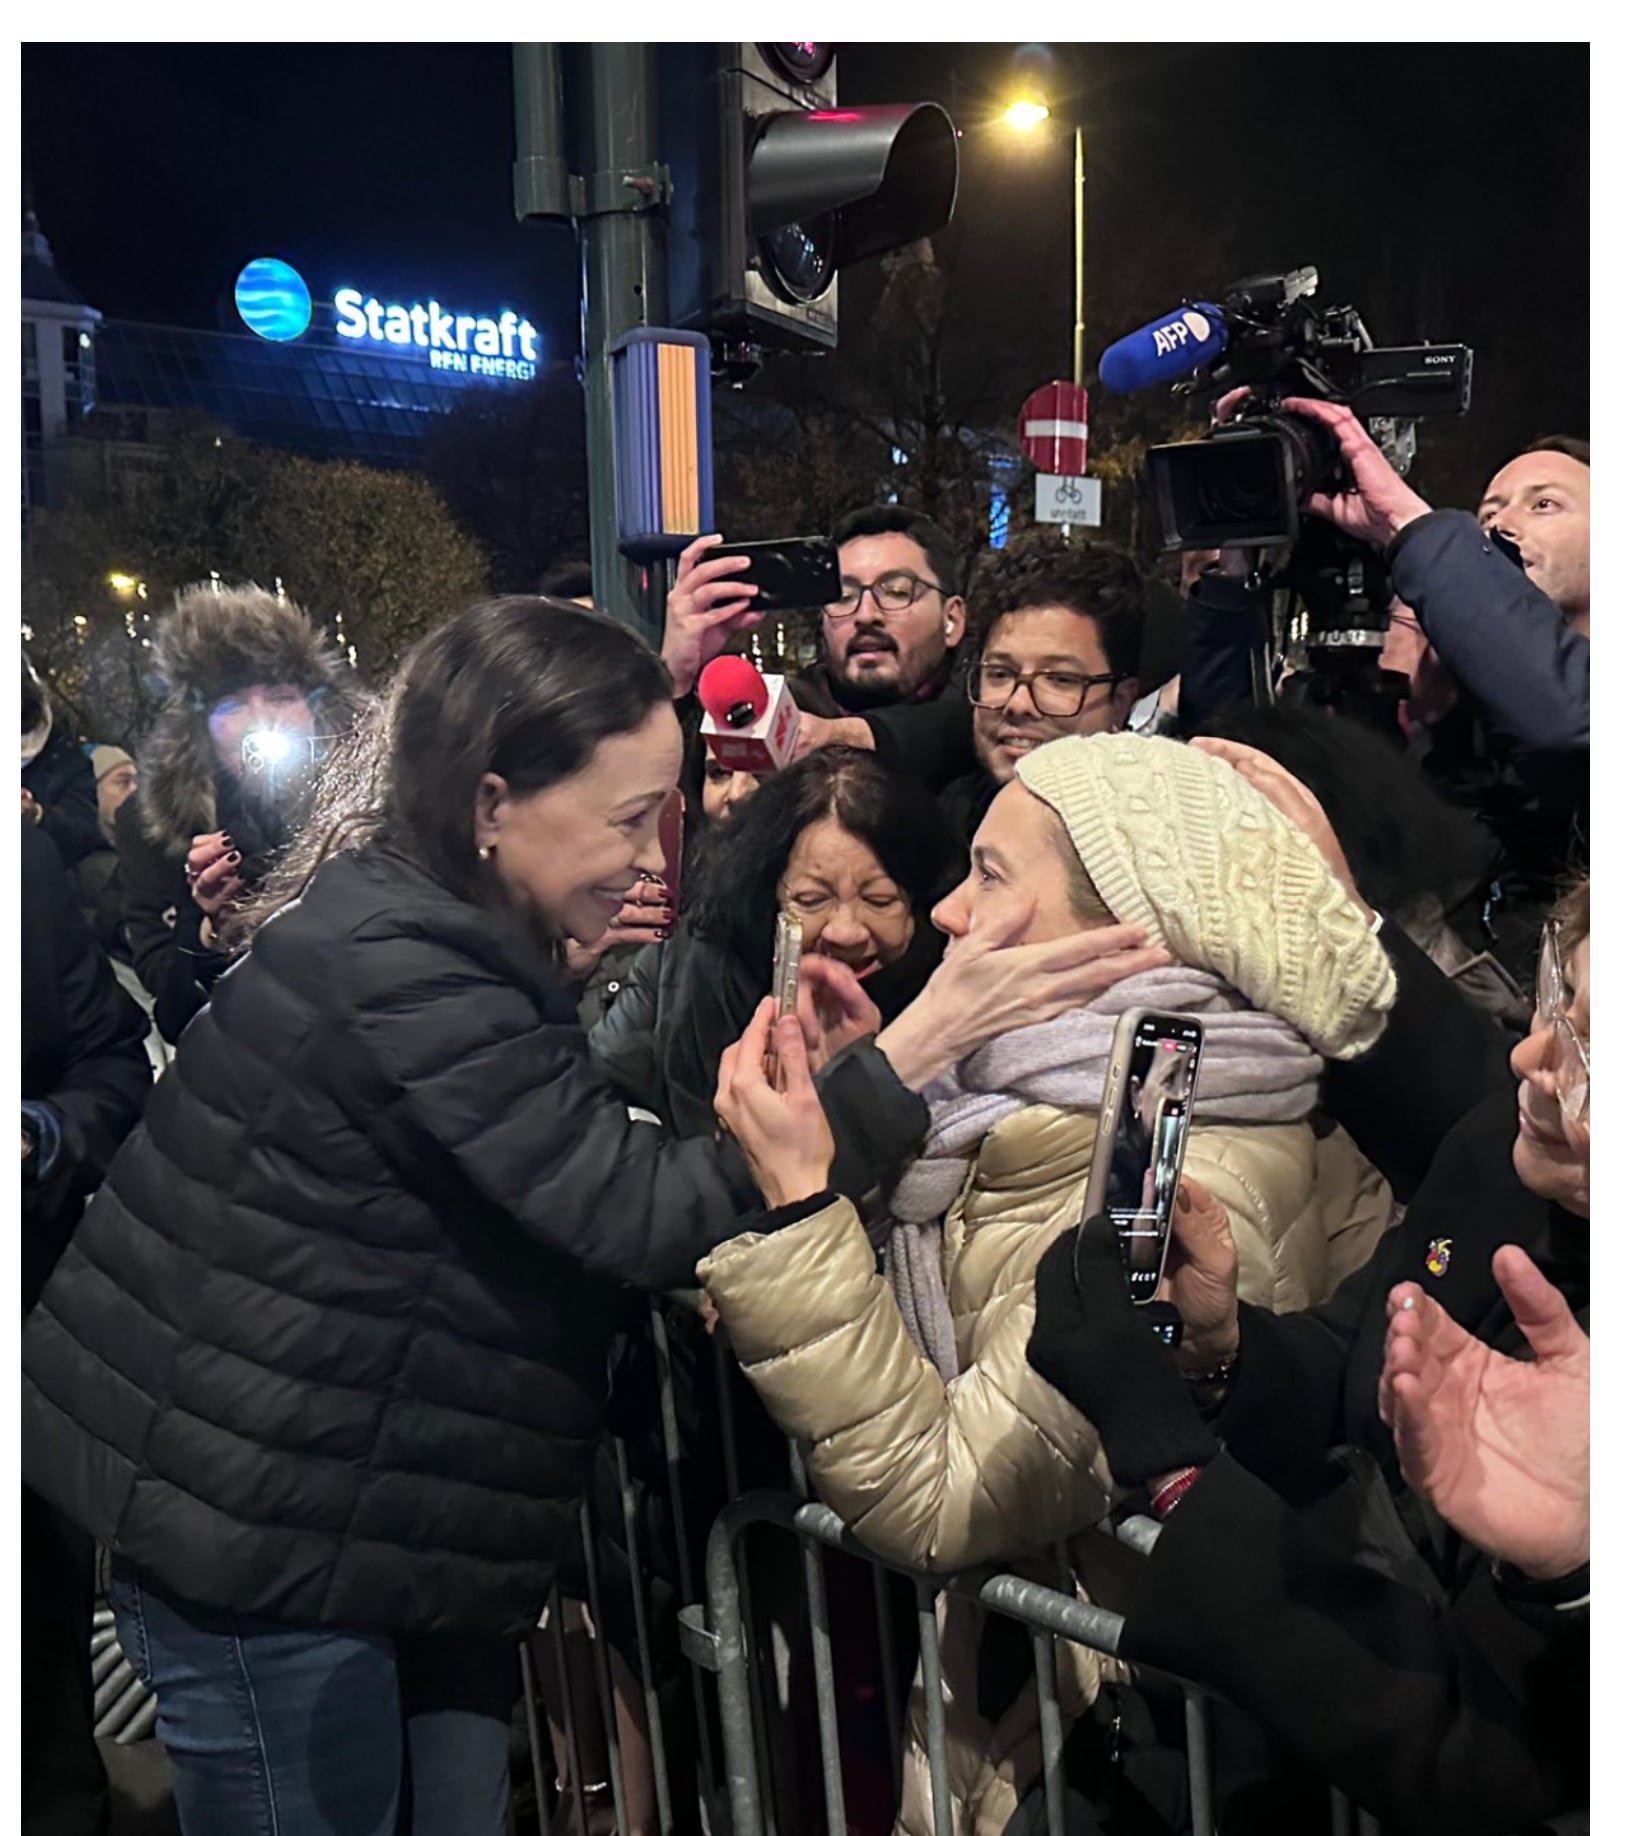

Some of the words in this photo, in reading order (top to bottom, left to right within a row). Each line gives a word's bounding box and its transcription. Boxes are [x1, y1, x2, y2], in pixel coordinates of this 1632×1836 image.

[334, 289, 537, 361] Statkraft
[1152, 321, 1188, 357] AFP
[1424, 355, 1456, 364] SONY
